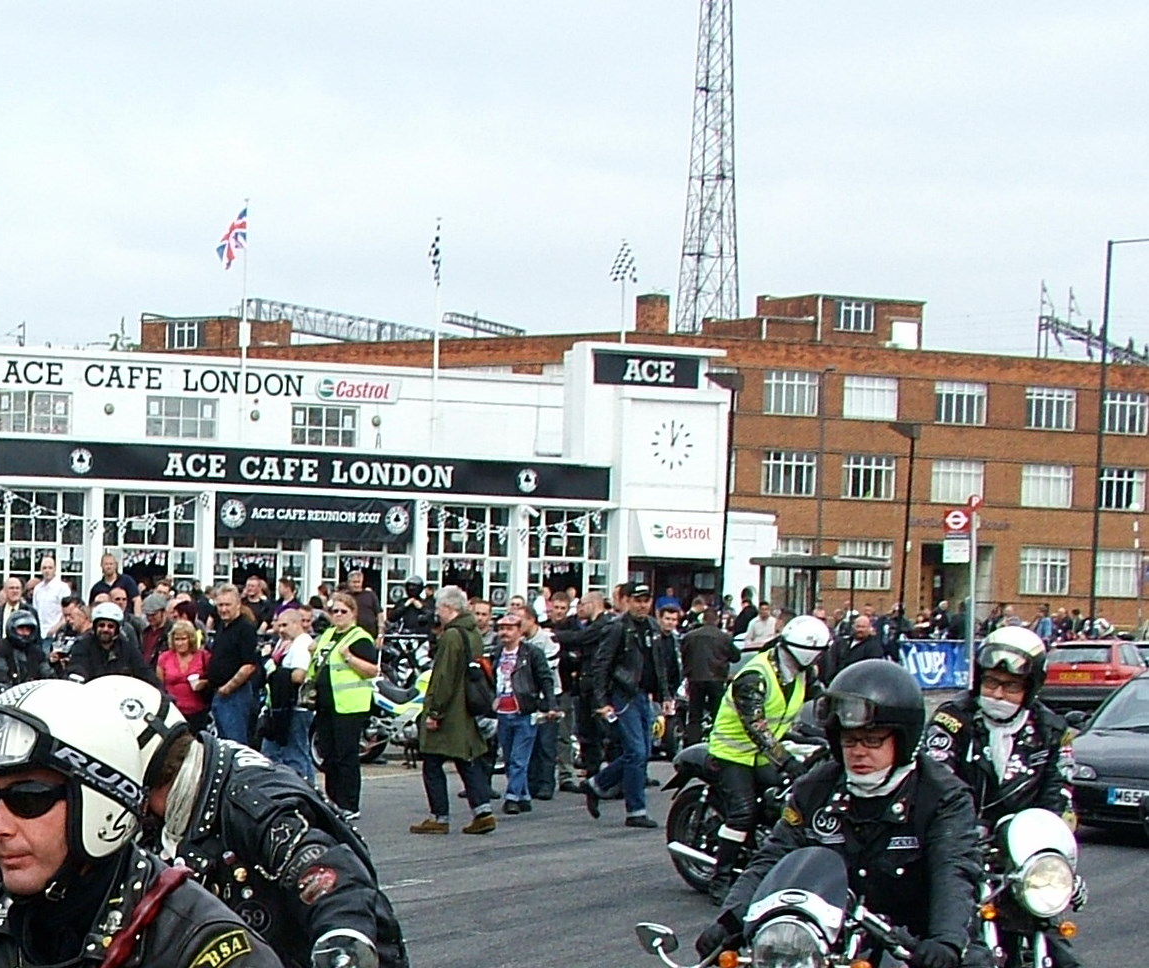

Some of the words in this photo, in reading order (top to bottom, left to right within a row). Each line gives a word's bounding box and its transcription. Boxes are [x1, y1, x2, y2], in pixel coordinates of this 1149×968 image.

[2, 360, 64, 386] ACE
[84, 364, 162, 390] CAFE
[183, 368, 304, 397] LONDON
[623, 358, 675, 383] ACE
[335, 379, 391, 400] Castrol
[163, 452, 226, 478] ACE
[240, 457, 319, 483] CAFE
[331, 460, 454, 489] LONDON
[251, 508, 275, 520] ACE
[276, 508, 306, 521] CAFE
[307, 510, 356, 523] REUNION
[357, 512, 381, 524] 2007
[666, 525, 711, 541] Castrol
[241, 908, 265, 927] 59
[198, 937, 242, 968] BSA
